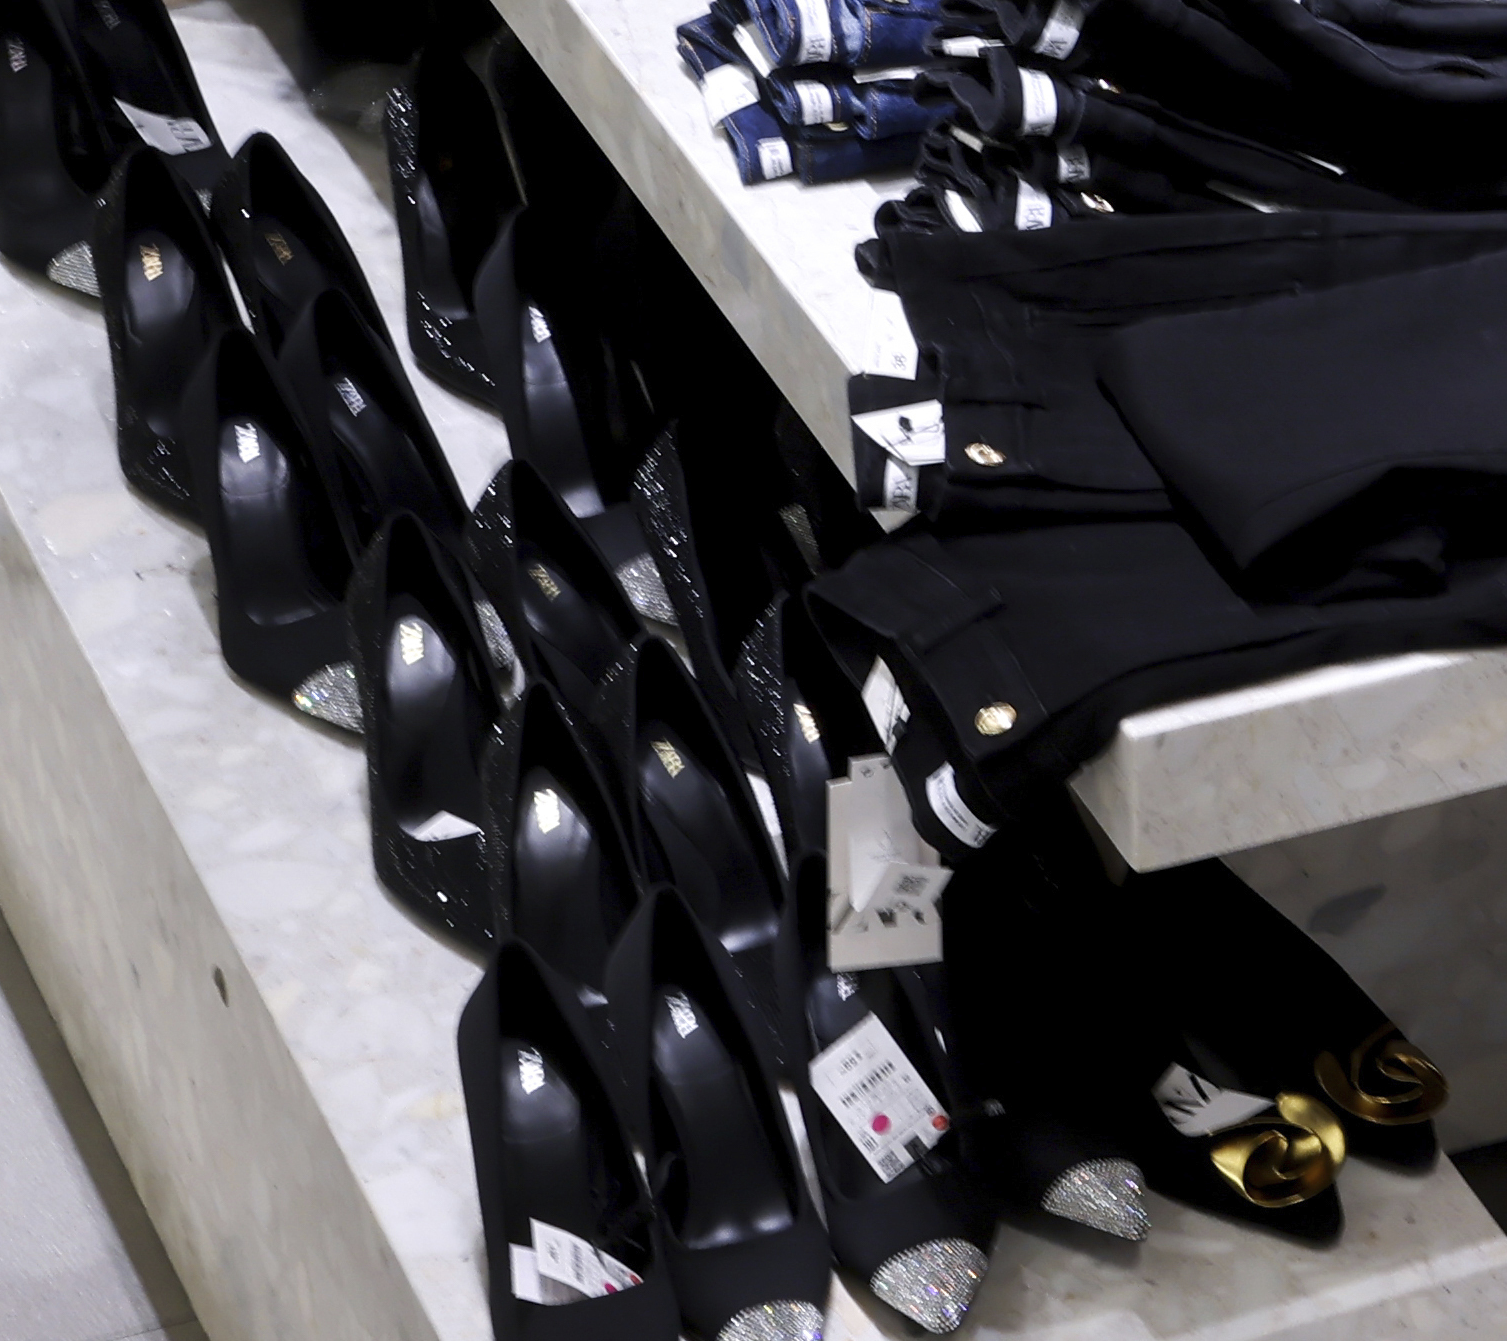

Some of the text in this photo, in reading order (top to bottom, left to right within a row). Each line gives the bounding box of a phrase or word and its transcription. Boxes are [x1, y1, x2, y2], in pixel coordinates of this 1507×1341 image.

[140, 243, 163, 282] ZARA
[335, 377, 367, 417] ZARA
[650, 736, 686, 779] ZARA
[534, 788, 561, 834] ZARA
[664, 991, 699, 1040] ZARA
[517, 1047, 547, 1095] ZARA
